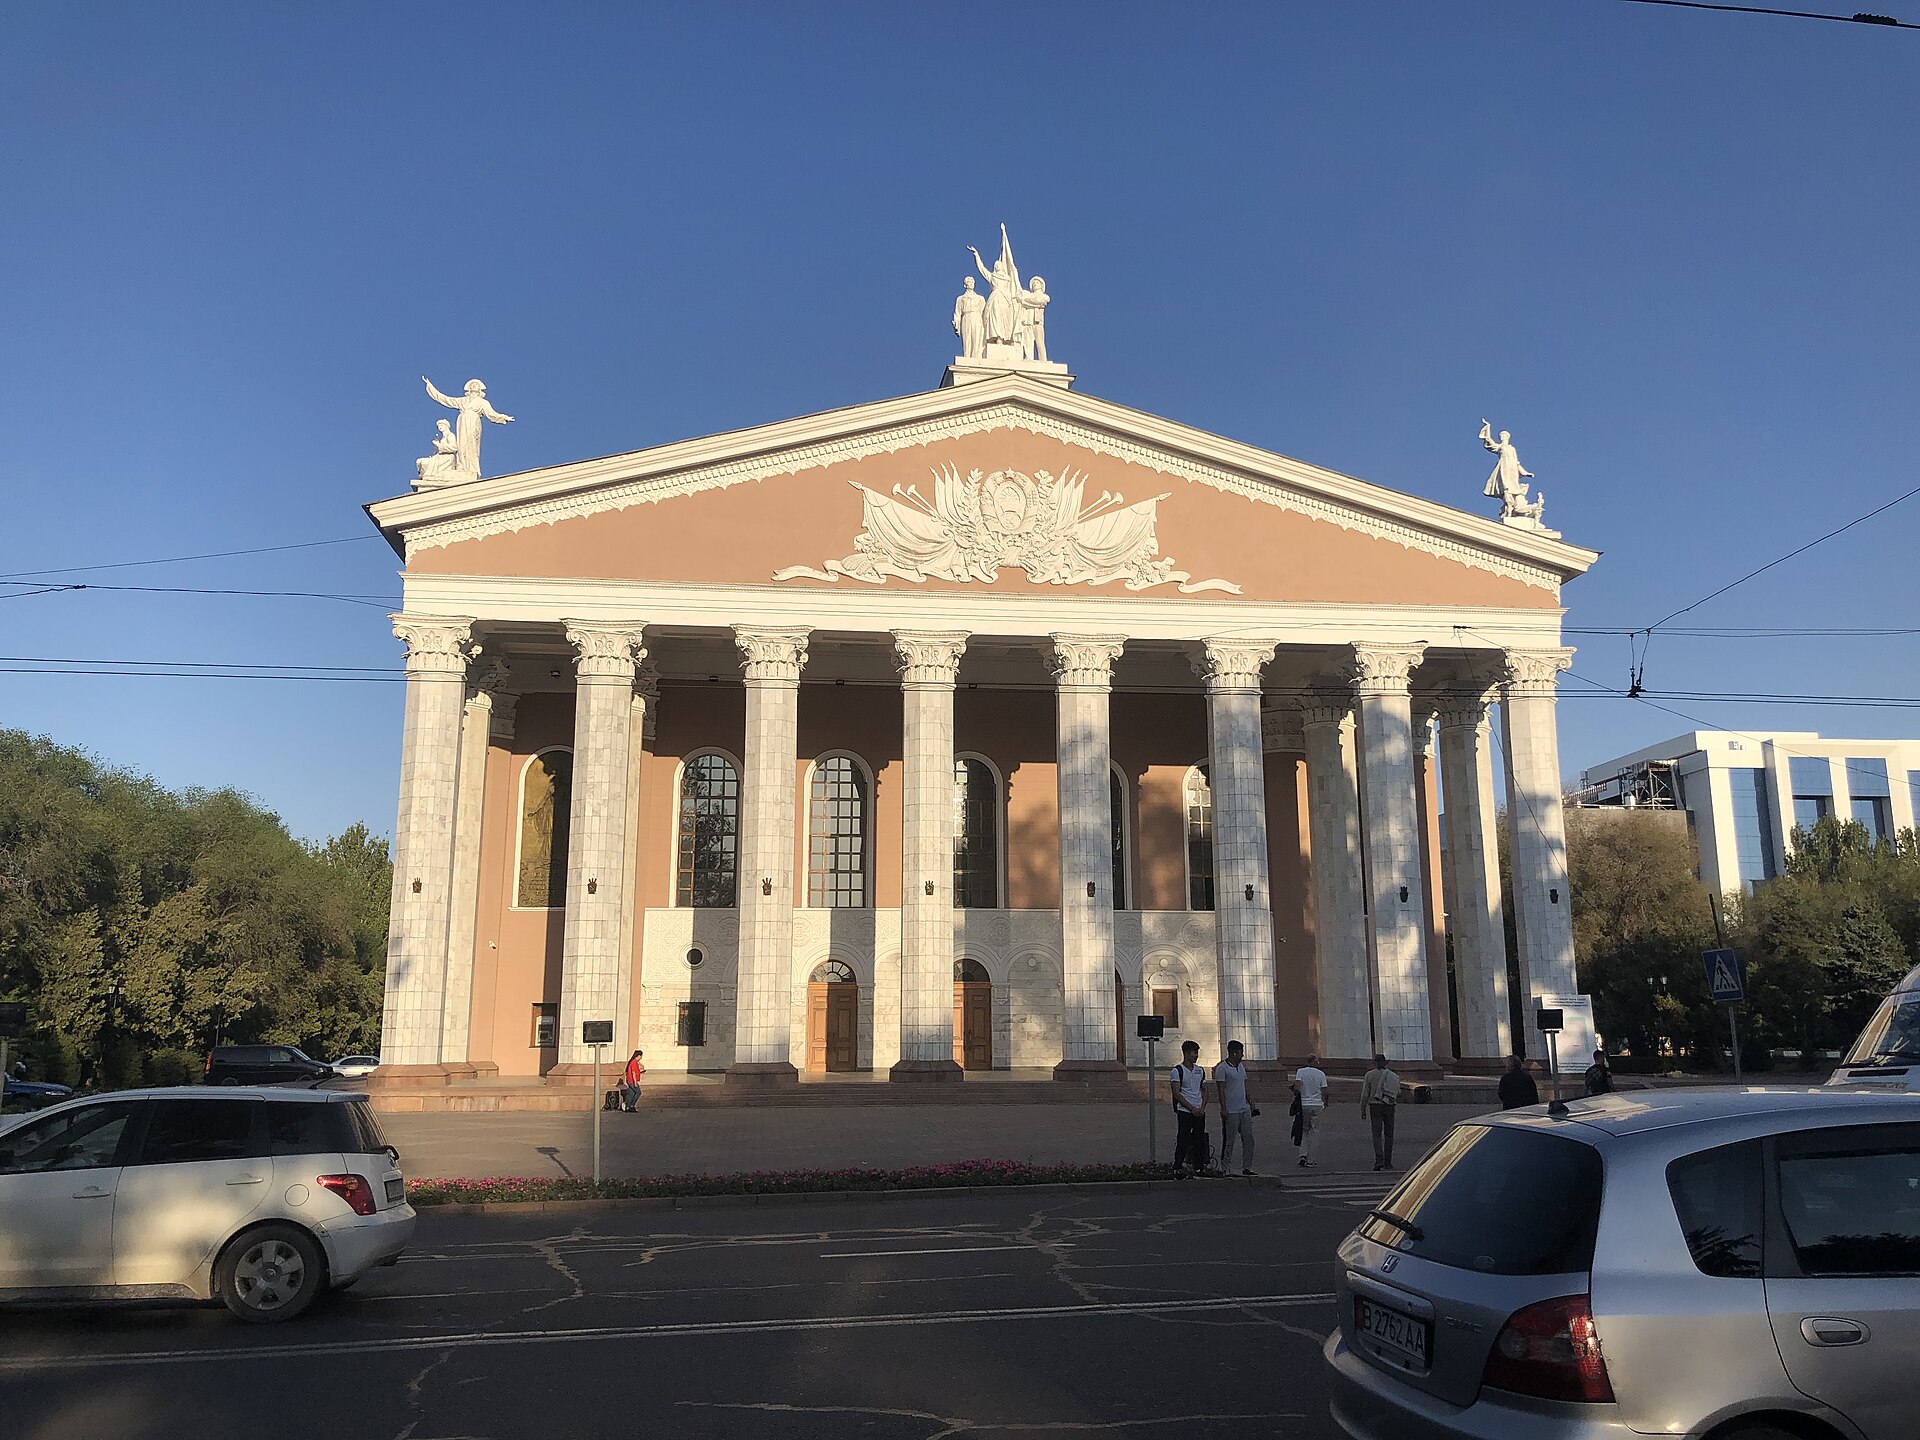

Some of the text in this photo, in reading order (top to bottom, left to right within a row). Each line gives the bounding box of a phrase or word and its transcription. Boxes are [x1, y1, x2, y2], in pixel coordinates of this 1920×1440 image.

[1362, 1304, 1372, 1331] B
[1375, 1309, 1403, 1345] 2762
[1405, 1321, 1425, 1356] AA
